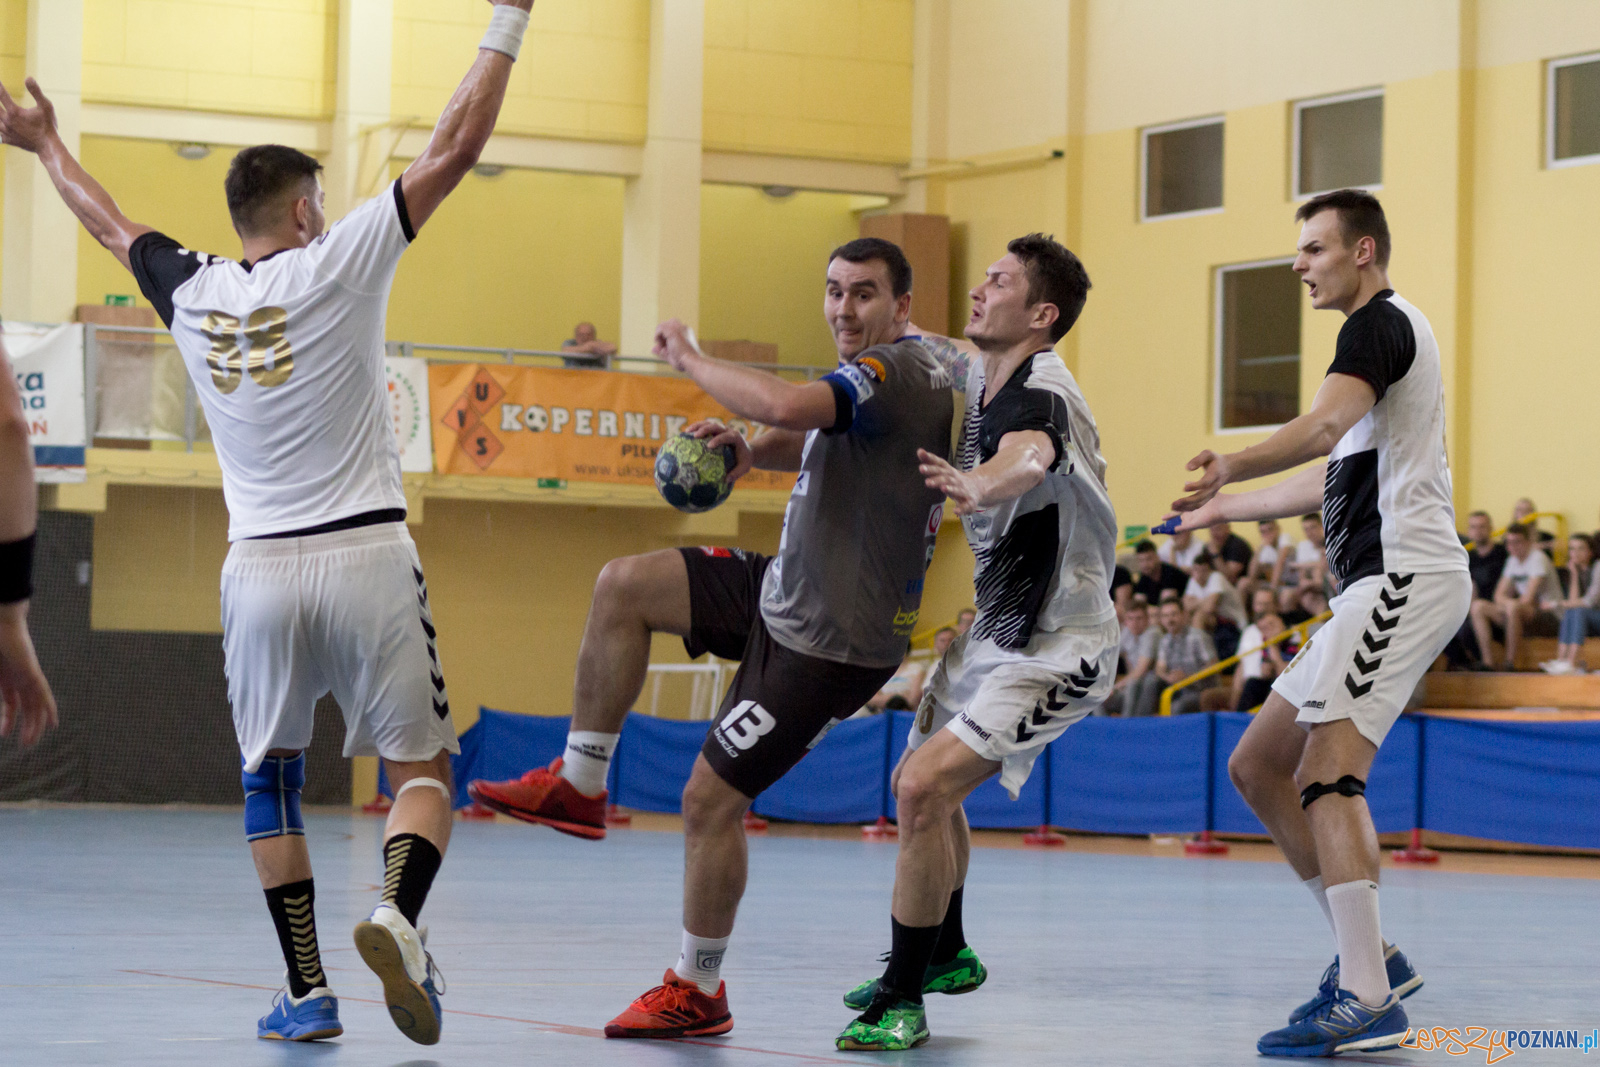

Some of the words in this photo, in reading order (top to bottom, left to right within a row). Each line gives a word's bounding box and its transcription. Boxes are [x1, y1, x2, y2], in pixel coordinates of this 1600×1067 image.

[201, 305, 295, 395] 88
[500, 403, 688, 442] KOPERNIK
[720, 699, 777, 751] 13
[960, 711, 992, 742] hummel
